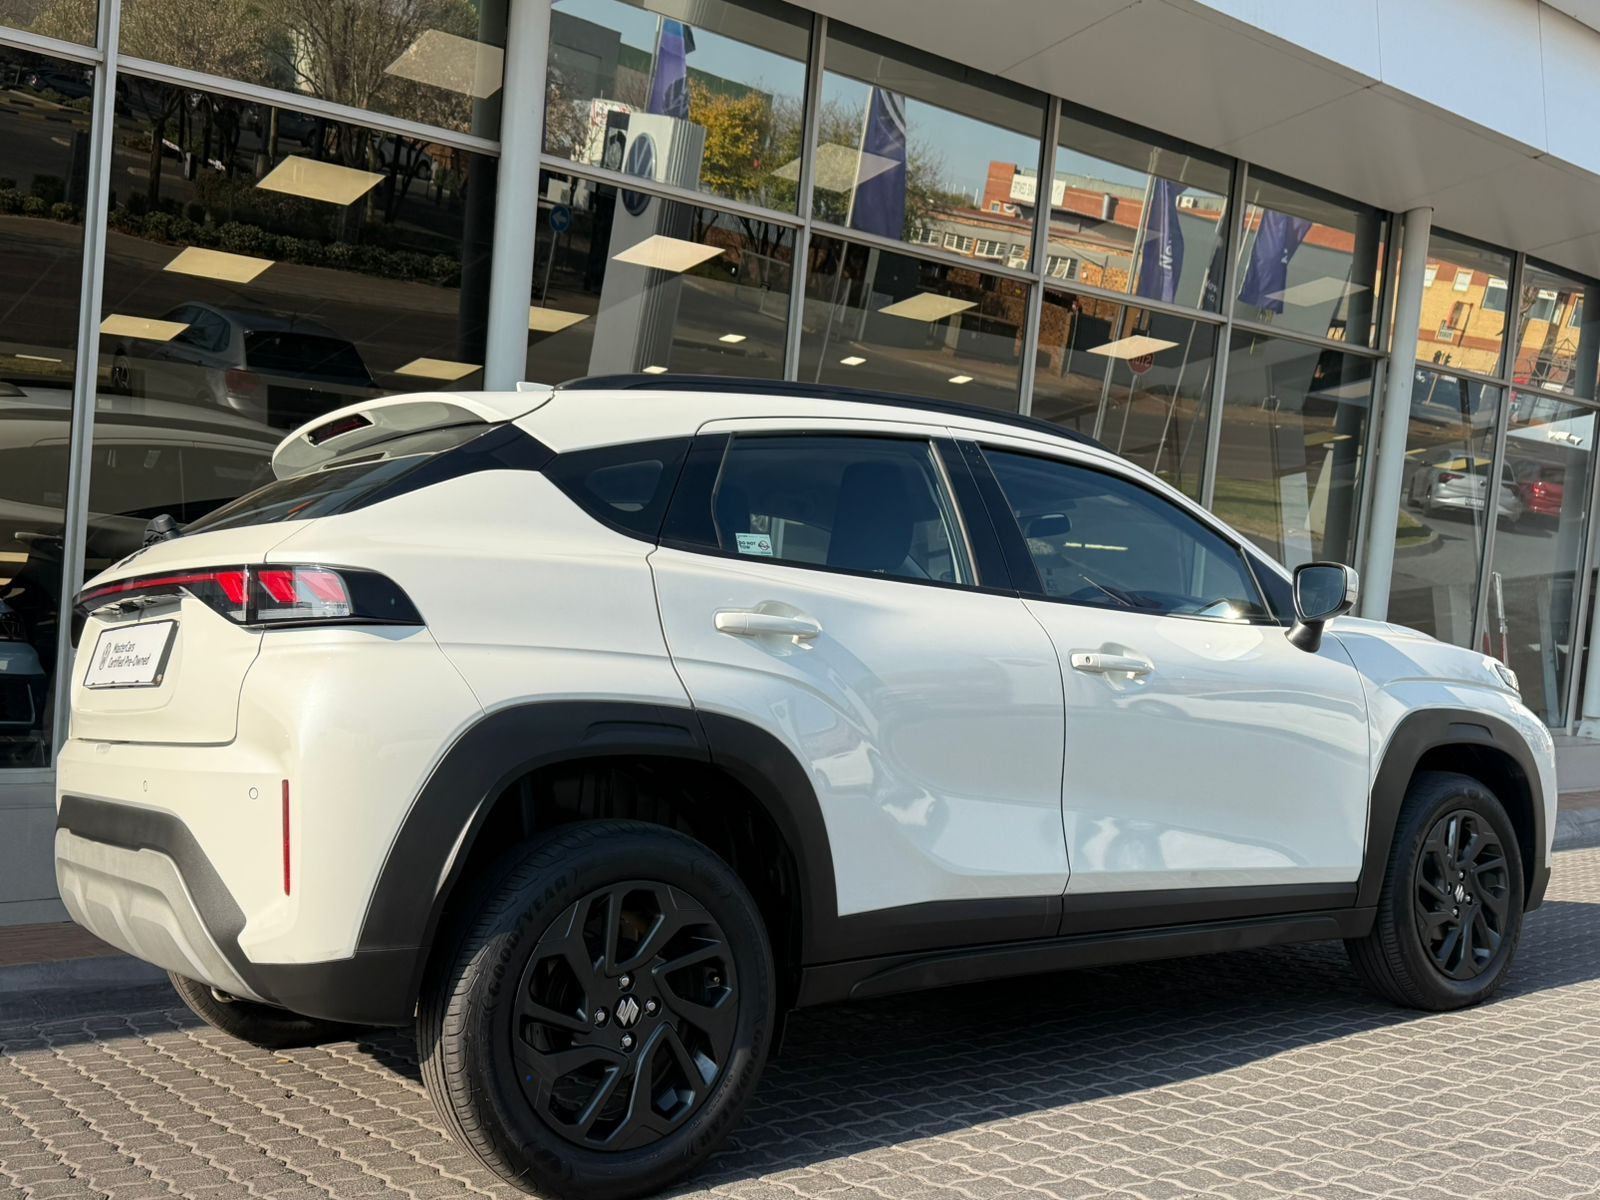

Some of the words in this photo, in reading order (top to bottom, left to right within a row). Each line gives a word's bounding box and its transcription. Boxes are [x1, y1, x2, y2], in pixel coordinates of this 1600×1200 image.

[107, 655, 126, 668] Certified
[125, 652, 152, 667] Pre-Owned
[487, 874, 568, 997] GOODYEAR
